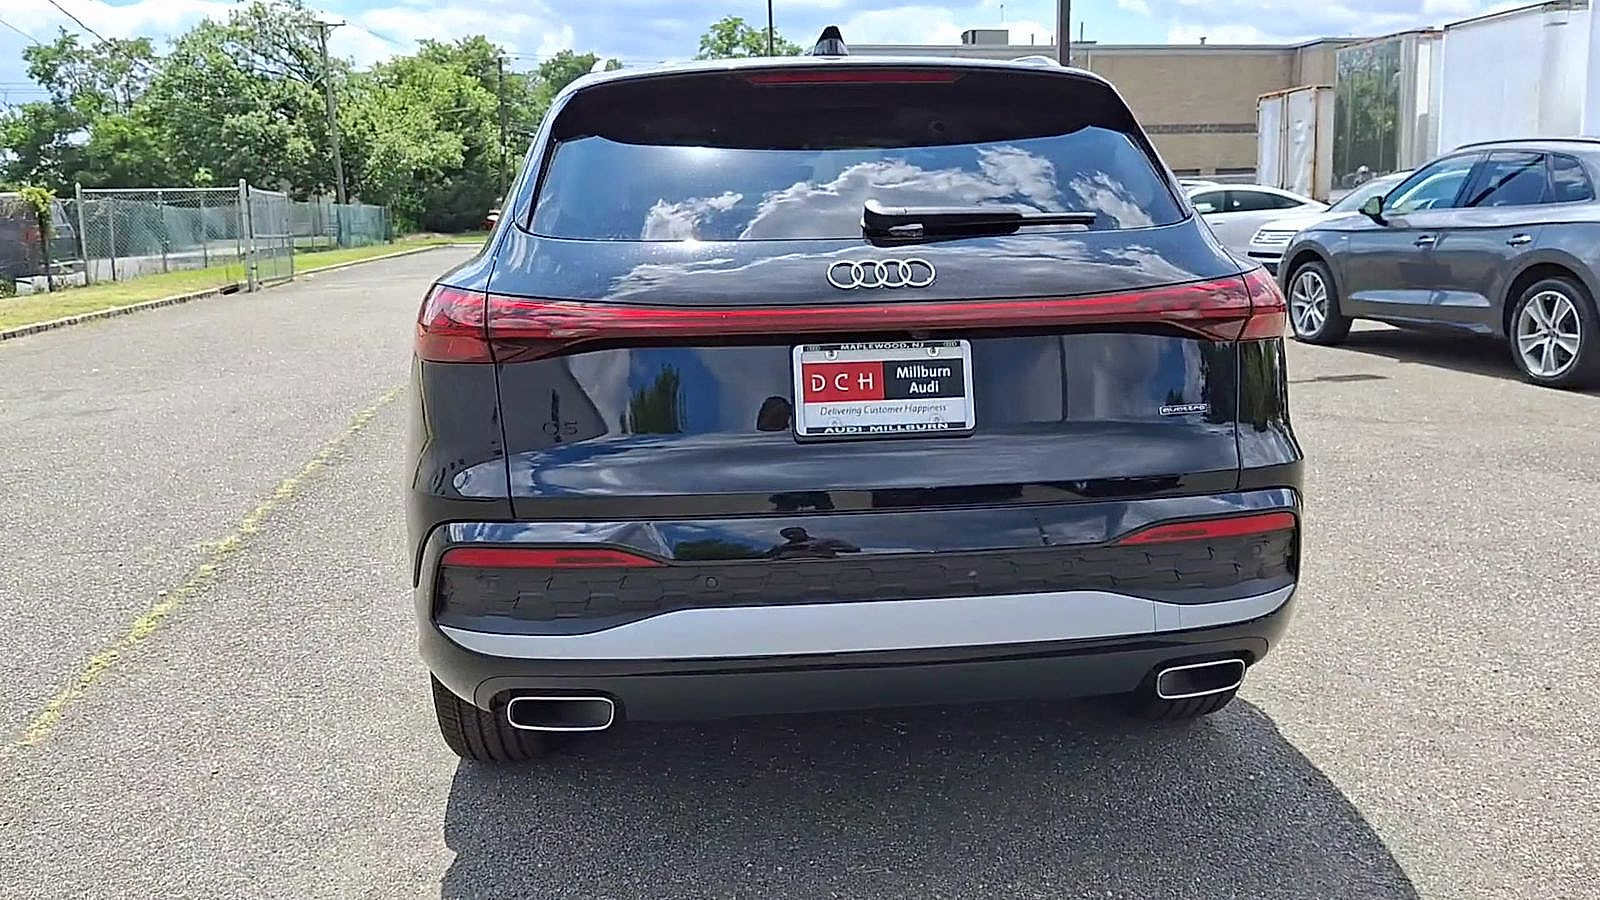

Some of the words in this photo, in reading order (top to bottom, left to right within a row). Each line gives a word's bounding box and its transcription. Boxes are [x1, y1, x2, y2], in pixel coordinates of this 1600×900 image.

[896, 366, 951, 379] Millburn
[909, 380, 939, 394] Audi
[820, 406, 862, 416] Delivering
[864, 405, 903, 414] Customer
[905, 403, 947, 414] Happiness
[824, 426, 863, 434] AUDI
[870, 423, 949, 432] MILLBURN
